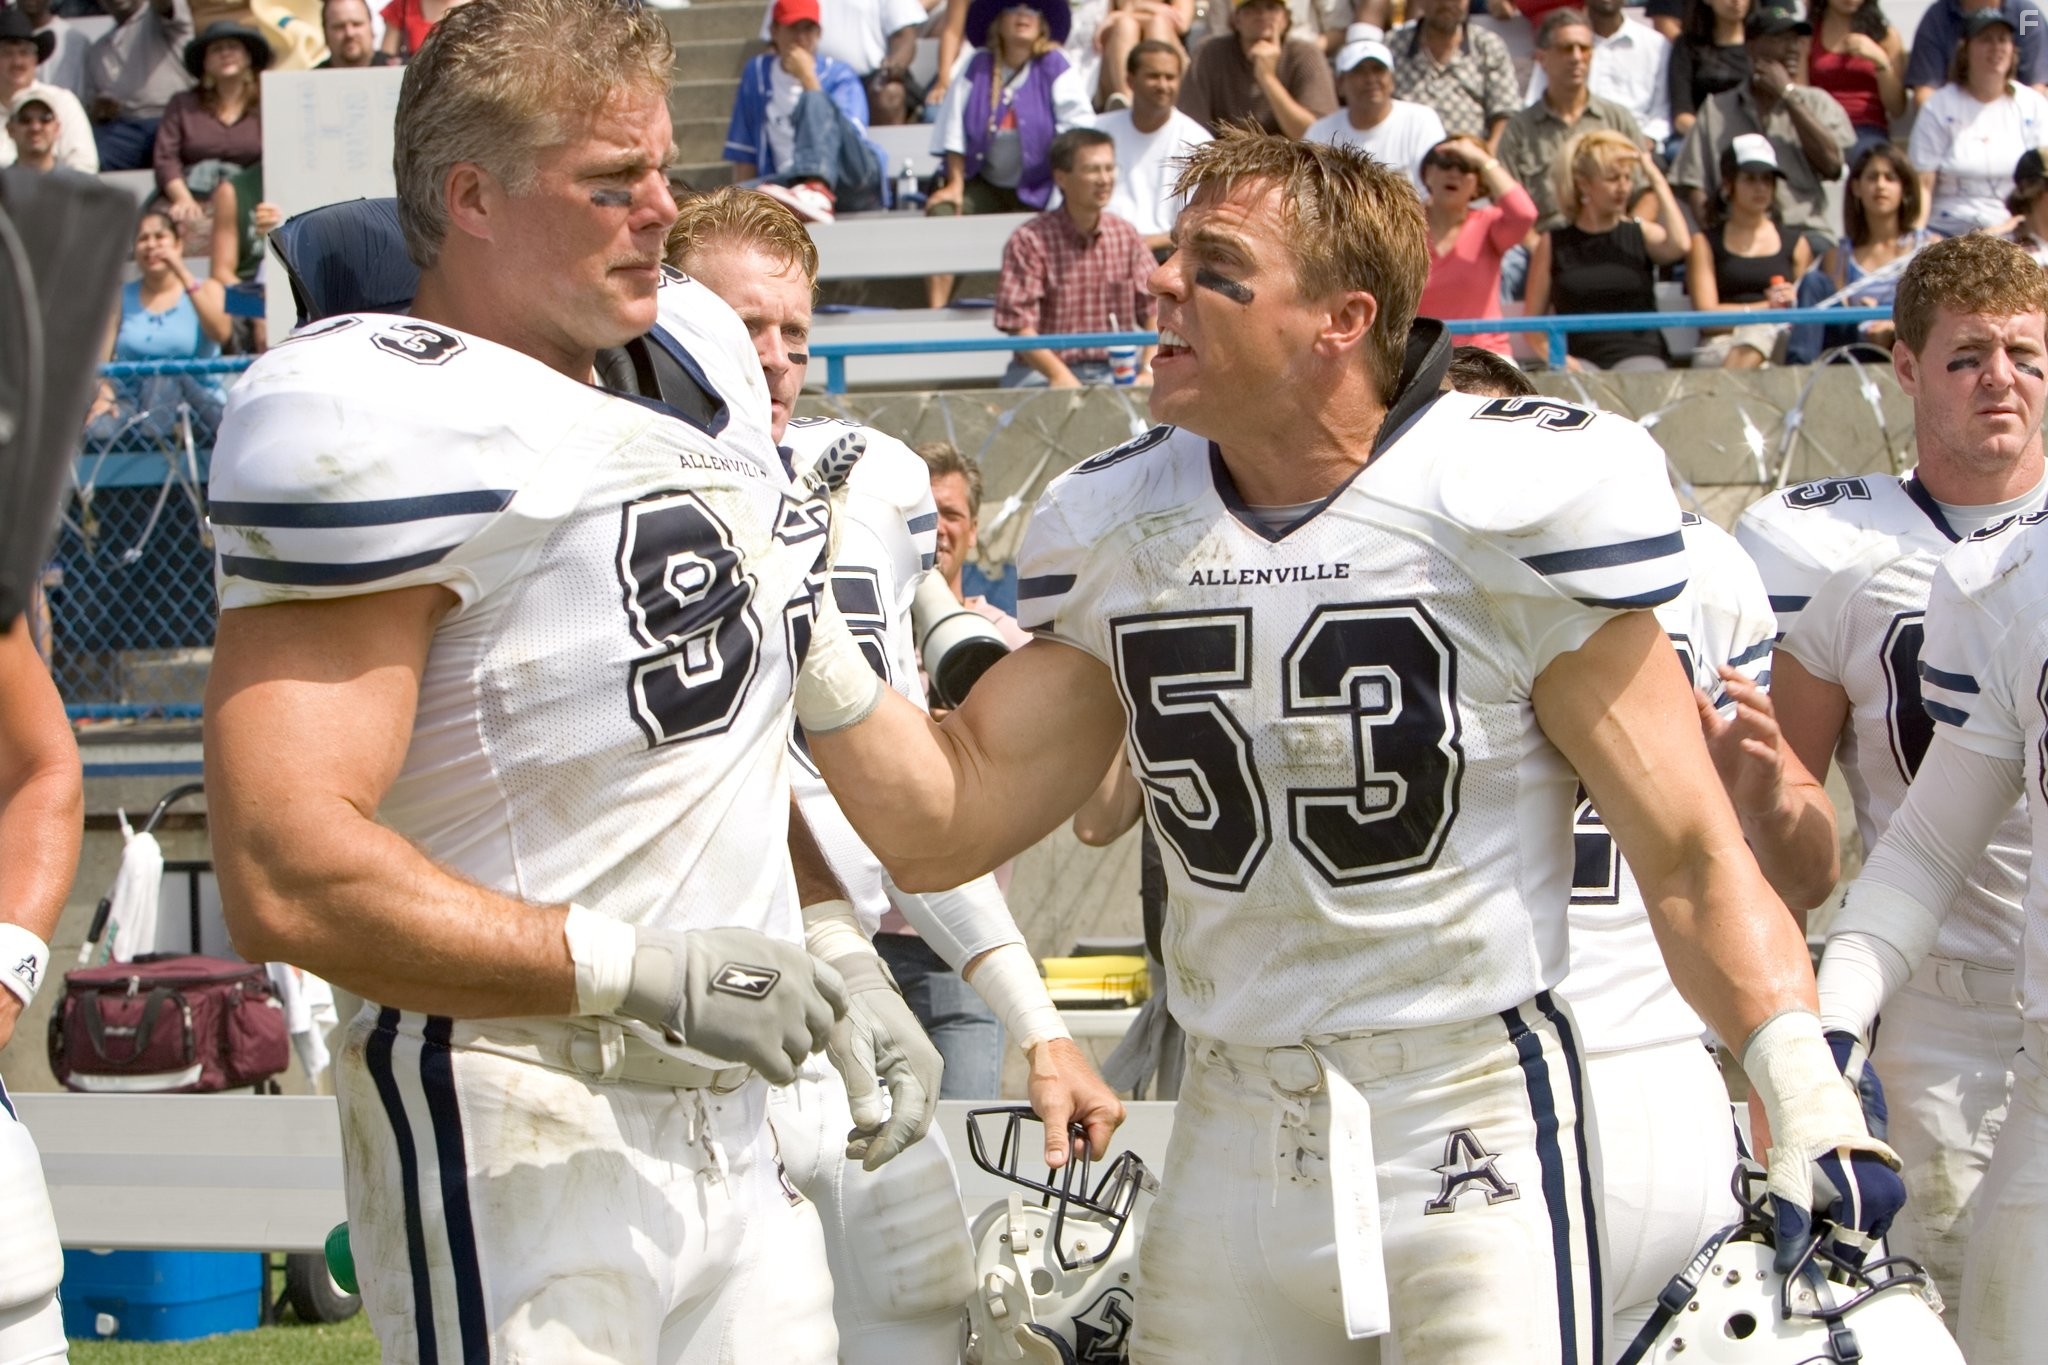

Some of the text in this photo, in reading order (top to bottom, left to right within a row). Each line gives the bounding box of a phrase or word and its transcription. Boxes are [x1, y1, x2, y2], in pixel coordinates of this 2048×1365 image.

[1188, 563, 1350, 586] ALLENVILLE
[1110, 599, 1465, 893] 53
[1424, 1128, 1520, 1215] A
